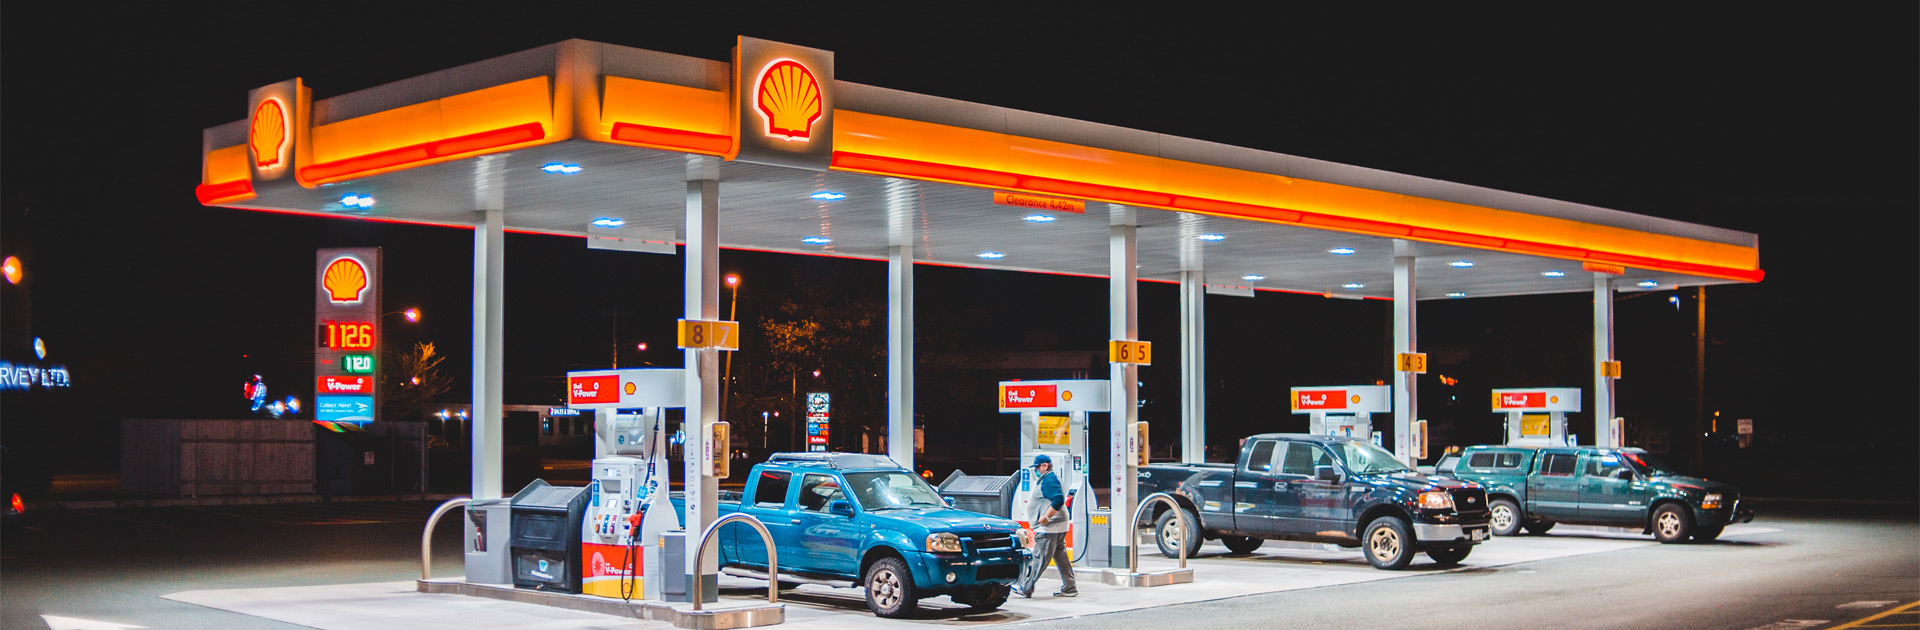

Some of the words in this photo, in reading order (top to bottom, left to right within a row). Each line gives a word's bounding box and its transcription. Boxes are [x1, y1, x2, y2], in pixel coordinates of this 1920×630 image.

[1006, 193, 1047, 208] Clearance
[1049, 199, 1074, 212] 4.42m
[328, 324, 373, 348] 112.6
[692, 324, 704, 345] 8
[719, 325, 730, 345] 7
[1120, 344, 1129, 360] 6
[1138, 345, 1146, 361] 5
[1405, 356, 1411, 369] 4
[1417, 356, 1423, 370] 3
[0, 367, 39, 386] RVEY
[327, 382, 361, 390] V-Power
[573, 389, 598, 398] V-Power
[1008, 395, 1034, 403] V-Power
